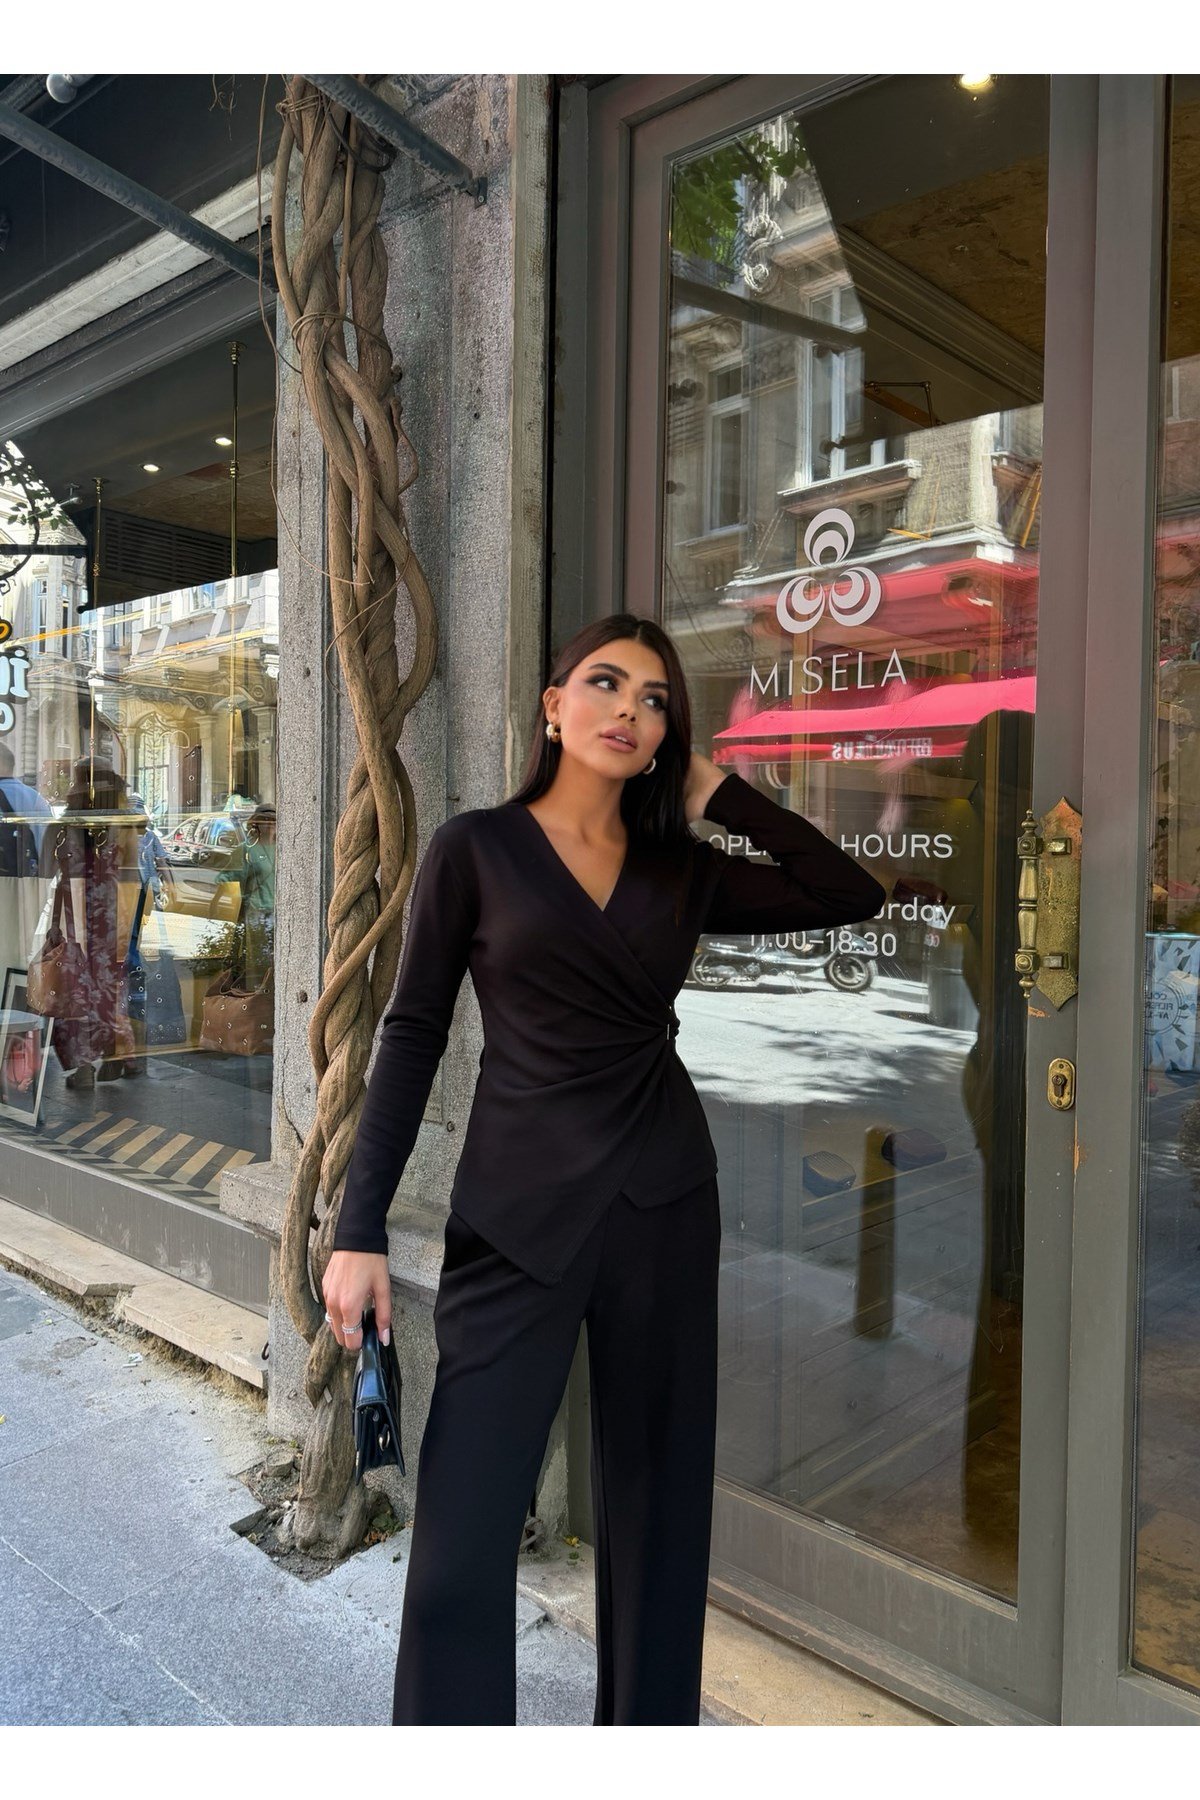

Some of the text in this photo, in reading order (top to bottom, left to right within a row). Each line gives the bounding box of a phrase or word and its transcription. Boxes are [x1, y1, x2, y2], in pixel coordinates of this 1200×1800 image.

[750, 648, 908, 700] MISELA
[708, 833, 954, 860] OPE HOURS
